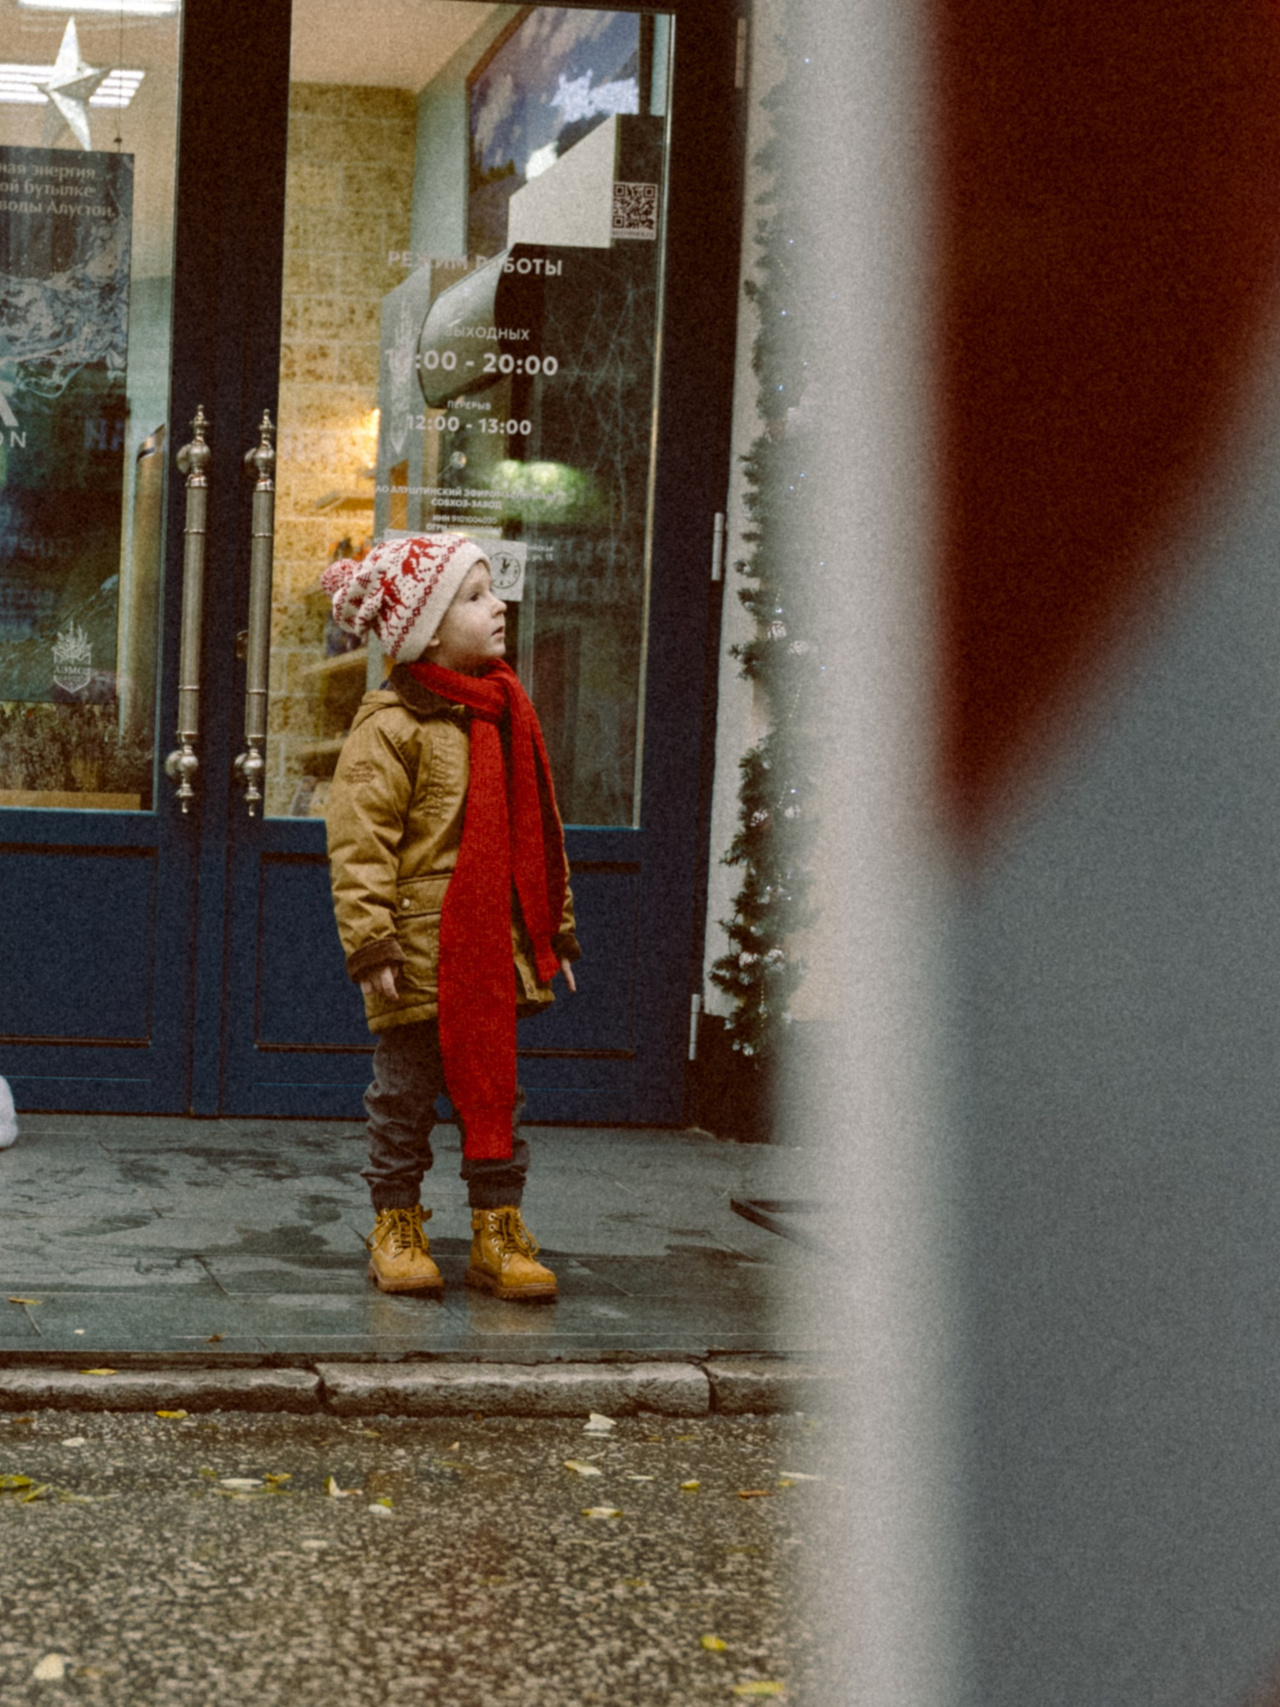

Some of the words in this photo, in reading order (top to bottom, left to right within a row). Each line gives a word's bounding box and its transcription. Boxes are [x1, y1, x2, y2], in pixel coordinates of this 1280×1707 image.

[32, 164, 96, 181] энергия
[24, 179, 94, 198] бутылке
[387, 251, 468, 271] РЕЖИМ
[482, 353, 558, 376] 20:00
[447, 400, 491, 411] ПЕРЕРЫВ
[407, 415, 460, 432] 12:00
[478, 418, 532, 435] 13:00
[431, 499, 502, 510] СОВХОЗ-ЗАВОД
